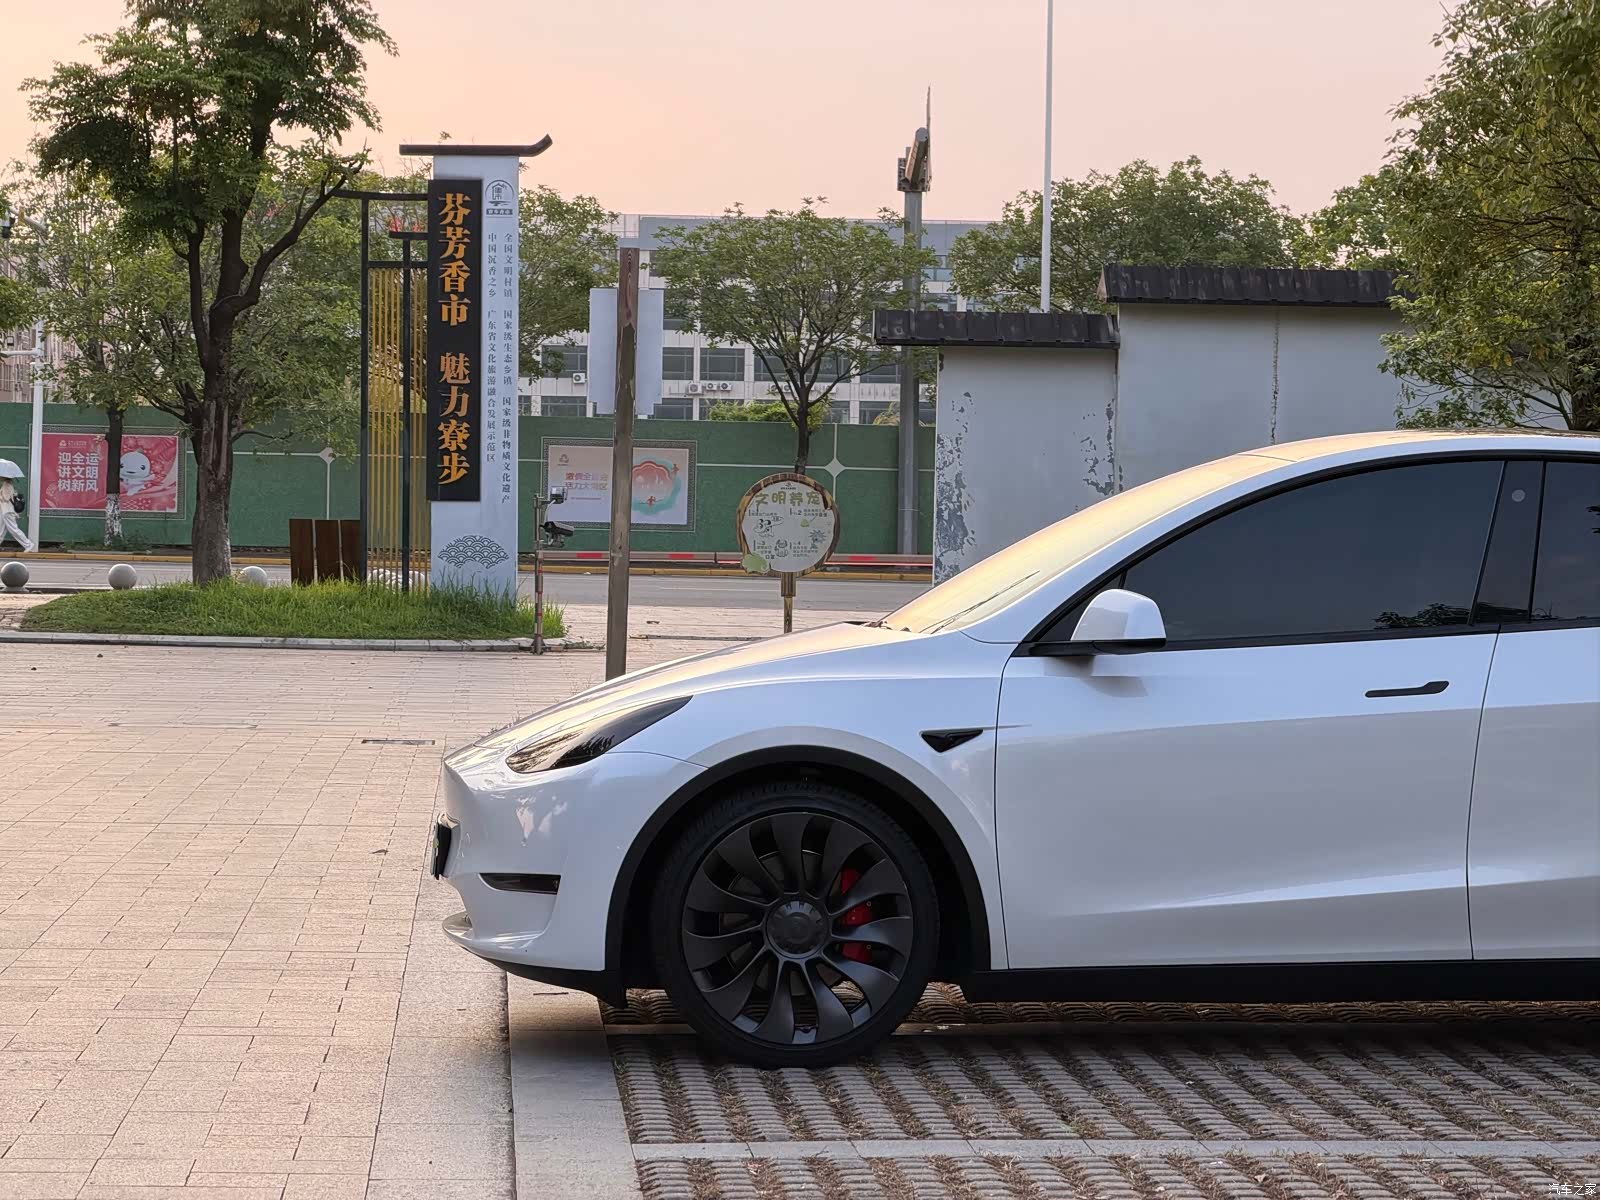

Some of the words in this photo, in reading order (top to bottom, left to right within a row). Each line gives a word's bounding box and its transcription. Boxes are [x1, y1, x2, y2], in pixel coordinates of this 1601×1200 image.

[438, 193, 471, 326] 芬芳香市
[487, 232, 497, 298] 中国沉香之乡
[503, 232, 513, 298] 全国文明村镇
[438, 352, 471, 485] 魅力寮步
[501, 397, 512, 504] 国家级非物质文化遗产
[58, 452, 99, 465] 迎全运
[58, 465, 99, 479] 讲文明
[58, 479, 99, 492] 树新风
